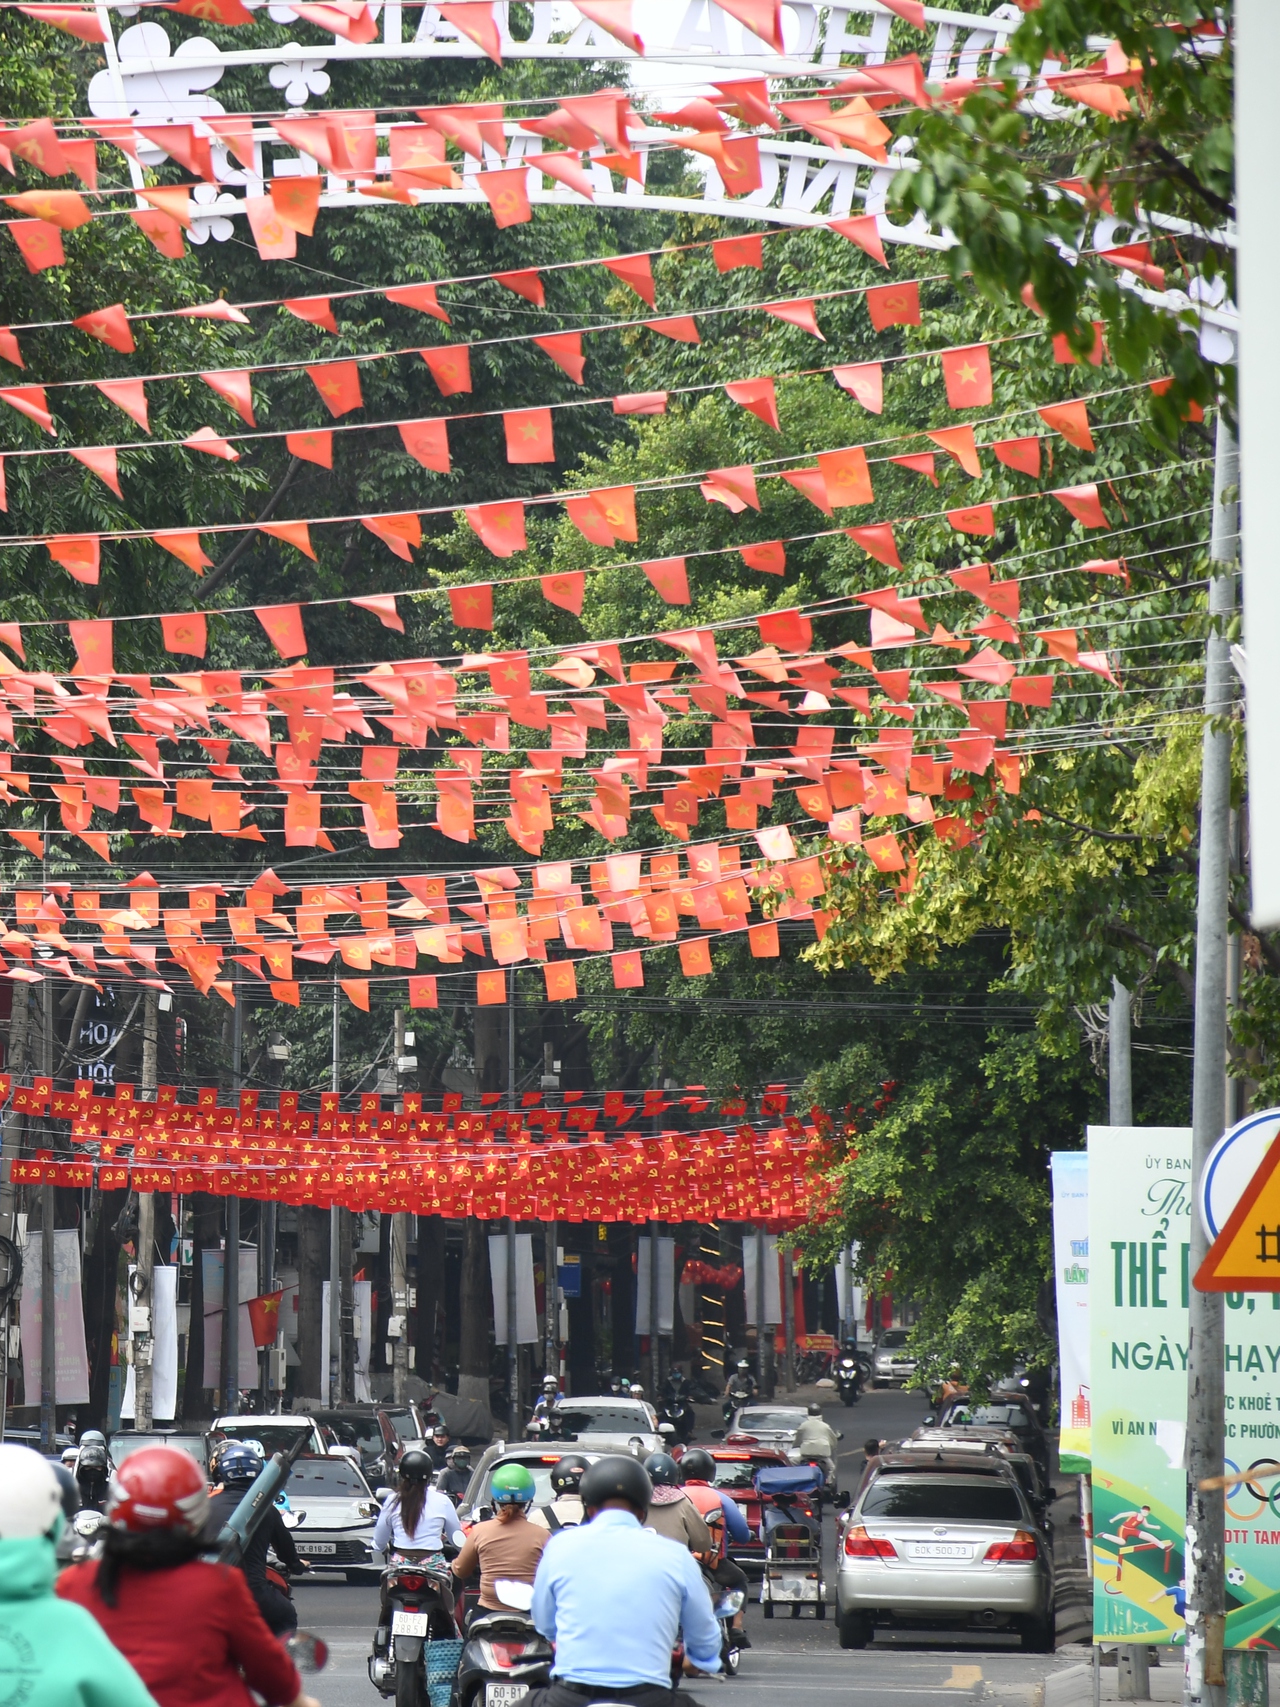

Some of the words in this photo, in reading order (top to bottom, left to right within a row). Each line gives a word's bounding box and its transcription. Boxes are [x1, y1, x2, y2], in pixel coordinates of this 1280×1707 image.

[1145, 1155, 1161, 1169] ỦY
[1166, 1158, 1191, 1170] BAN
[1111, 1217, 1169, 1308] THỂ
[1111, 1335, 1189, 1371] NGÀY
[1224, 1344, 1280, 1382] HẠY
[1239, 1392, 1272, 1411] KHOẺ
[1112, 1418, 1124, 1435] VÌ
[1127, 1421, 1145, 1436] AN
[1240, 1420, 1280, 1439] PHƯỜN
[1224, 1529, 1248, 1544] DTT
[914, 1546, 967, 1555] 60K-500.73
[398, 1613, 422, 1624] 60-F2
[395, 1624, 423, 1635] 288.51
[494, 1687, 522, 1699] 60-B1
